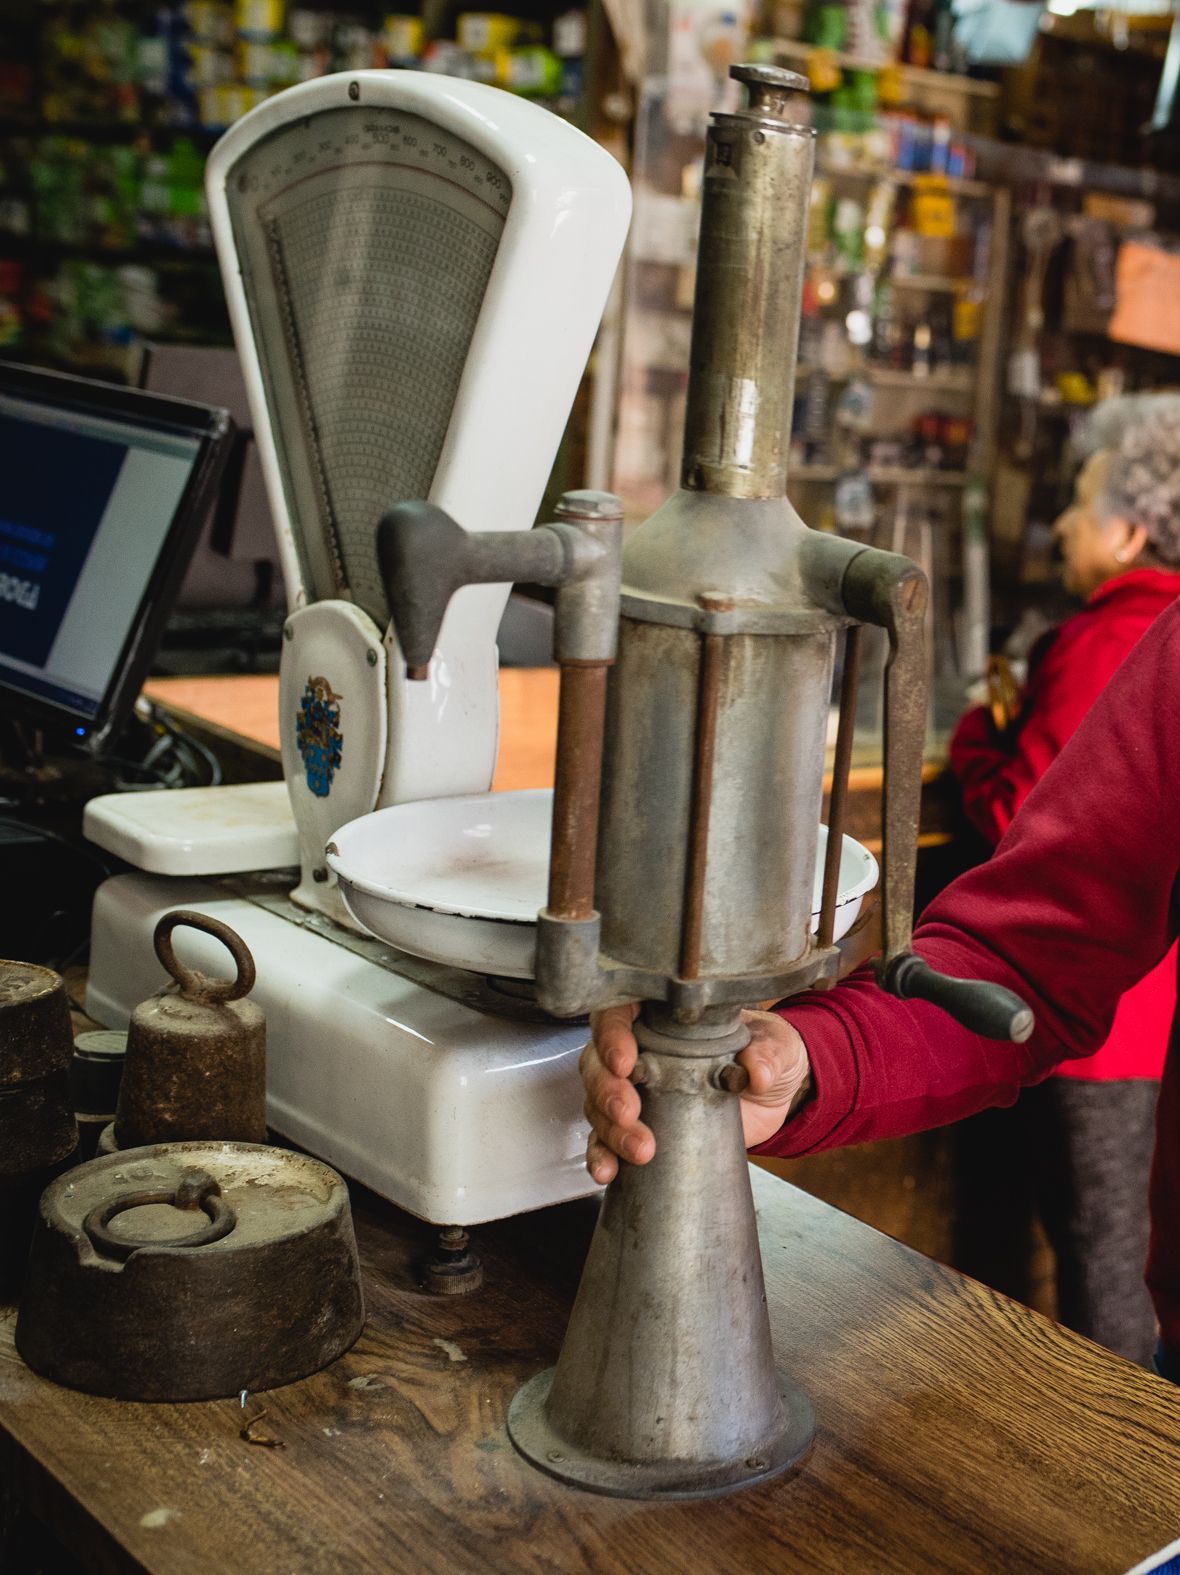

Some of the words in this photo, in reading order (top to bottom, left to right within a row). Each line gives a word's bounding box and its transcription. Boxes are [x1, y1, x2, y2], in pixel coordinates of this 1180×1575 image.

[433, 143, 447, 157] 700
[460, 156, 475, 171] 800
[486, 172, 501, 189] 900
